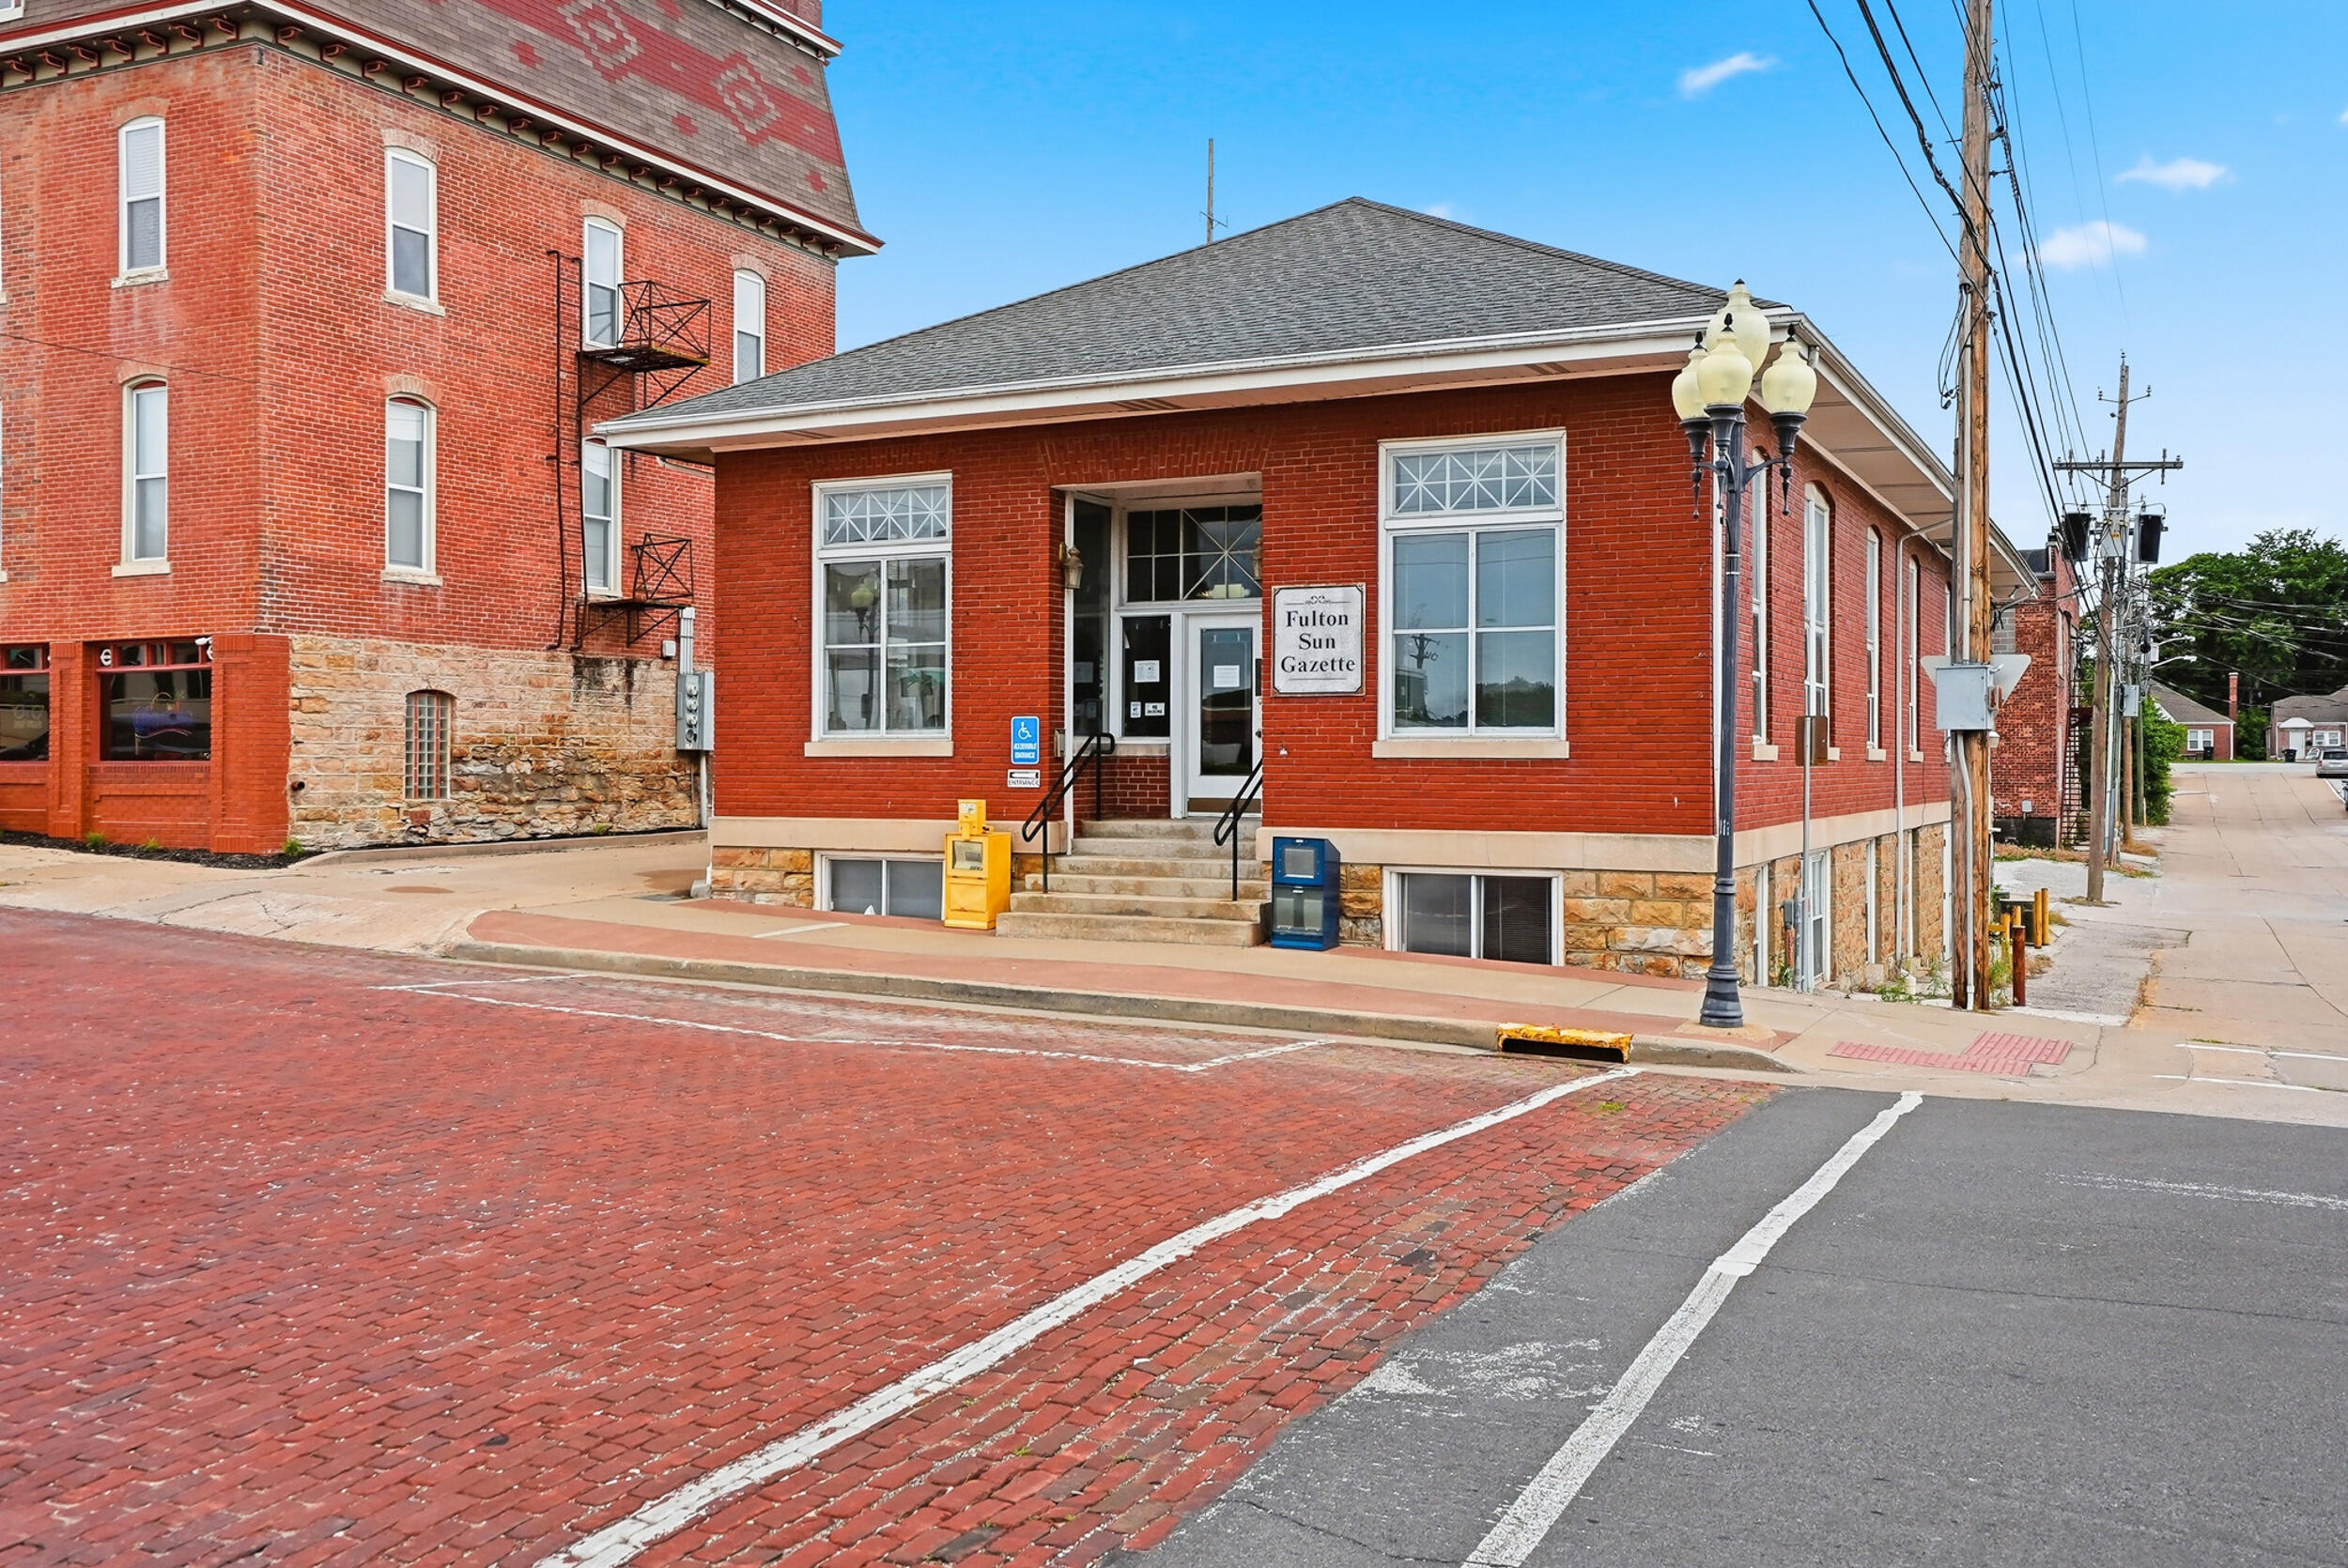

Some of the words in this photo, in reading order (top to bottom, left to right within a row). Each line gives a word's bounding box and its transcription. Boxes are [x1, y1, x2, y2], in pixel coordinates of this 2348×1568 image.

[1286, 610, 1349, 627] Fulton
[1298, 633, 1336, 650] Sun
[1280, 655, 1355, 673] Gazette
